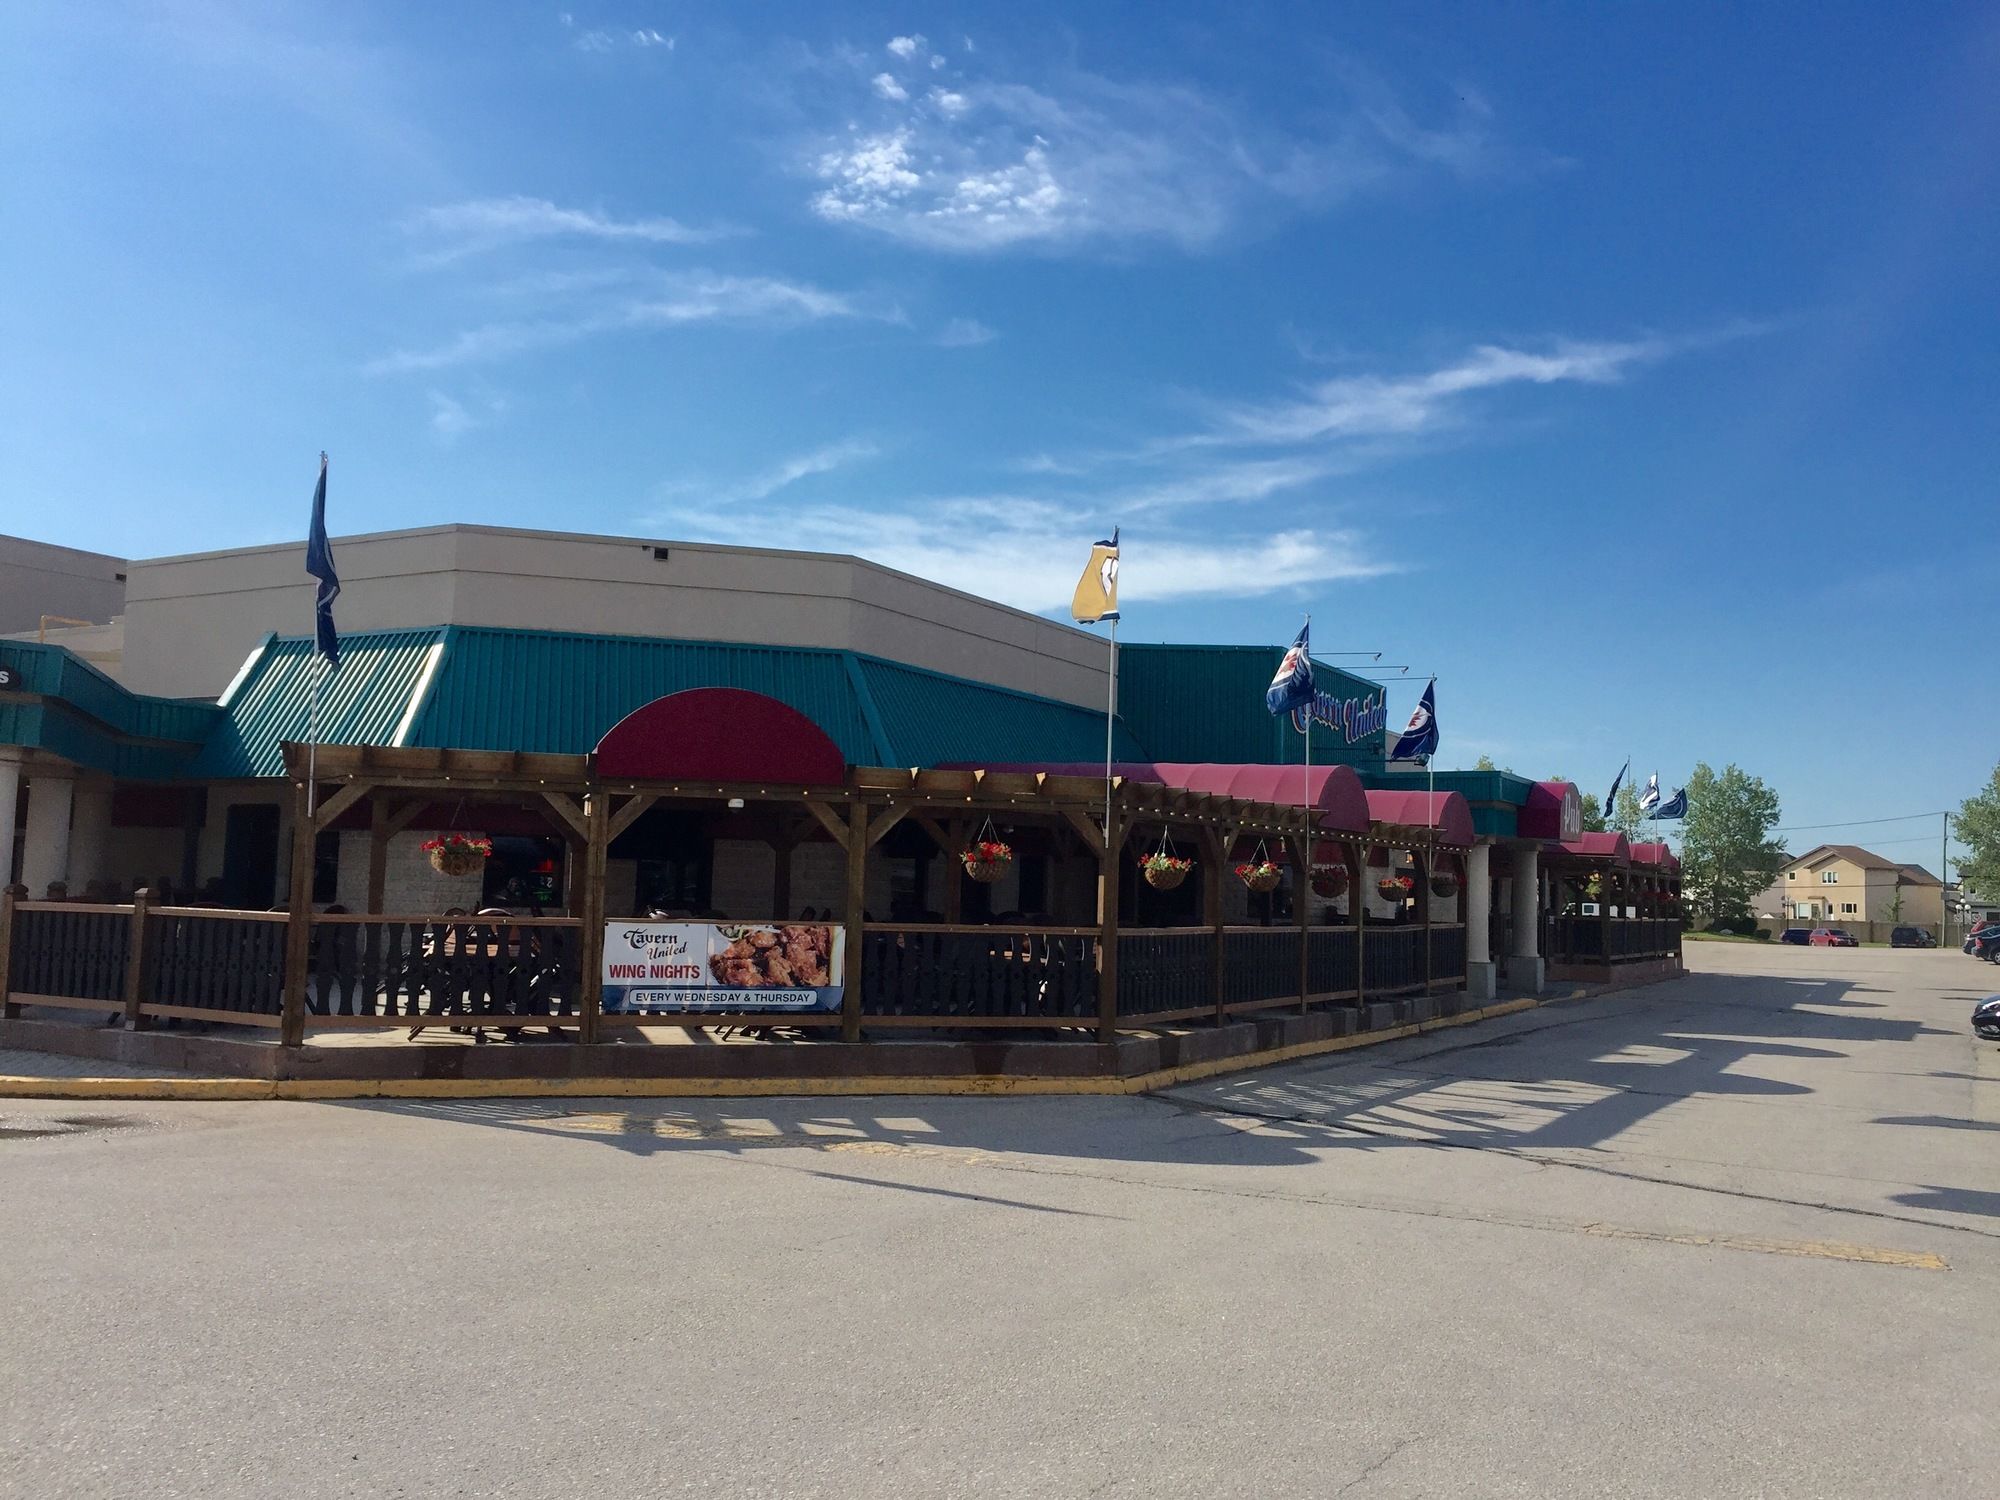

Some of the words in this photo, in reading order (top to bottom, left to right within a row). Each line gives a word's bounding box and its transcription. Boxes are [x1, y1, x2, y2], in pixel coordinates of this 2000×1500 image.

[1564, 791, 1580, 834] Pub
[623, 928, 678, 949] Tavern
[647, 941, 688, 960] United
[609, 964, 646, 979] WING
[650, 964, 700, 979] NIGHTS
[636, 992, 671, 1002] EVERY
[674, 992, 740, 1003] WEDNESDAY
[743, 993, 751, 1003] &
[754, 993, 810, 1003] THURSDAY
